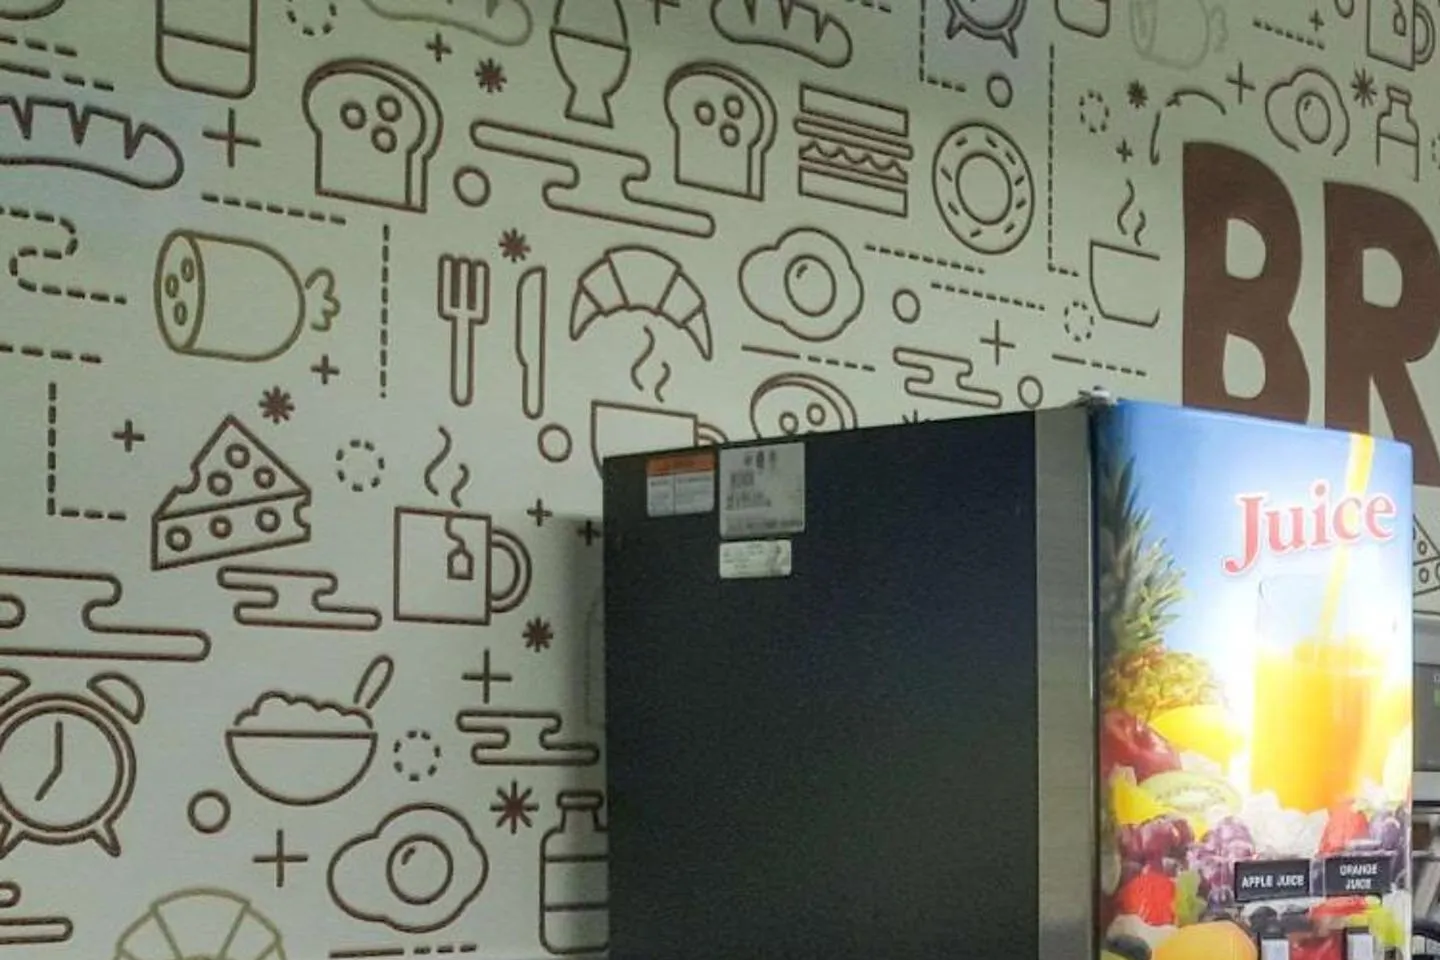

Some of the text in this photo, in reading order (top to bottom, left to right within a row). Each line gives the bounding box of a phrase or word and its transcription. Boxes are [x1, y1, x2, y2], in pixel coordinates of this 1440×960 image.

[1222, 481, 1395, 576] Juice
[1339, 863, 1378, 877] ORANGE
[1241, 873, 1305, 889] APPLE JUICE
[1344, 878, 1373, 890] JUICE
